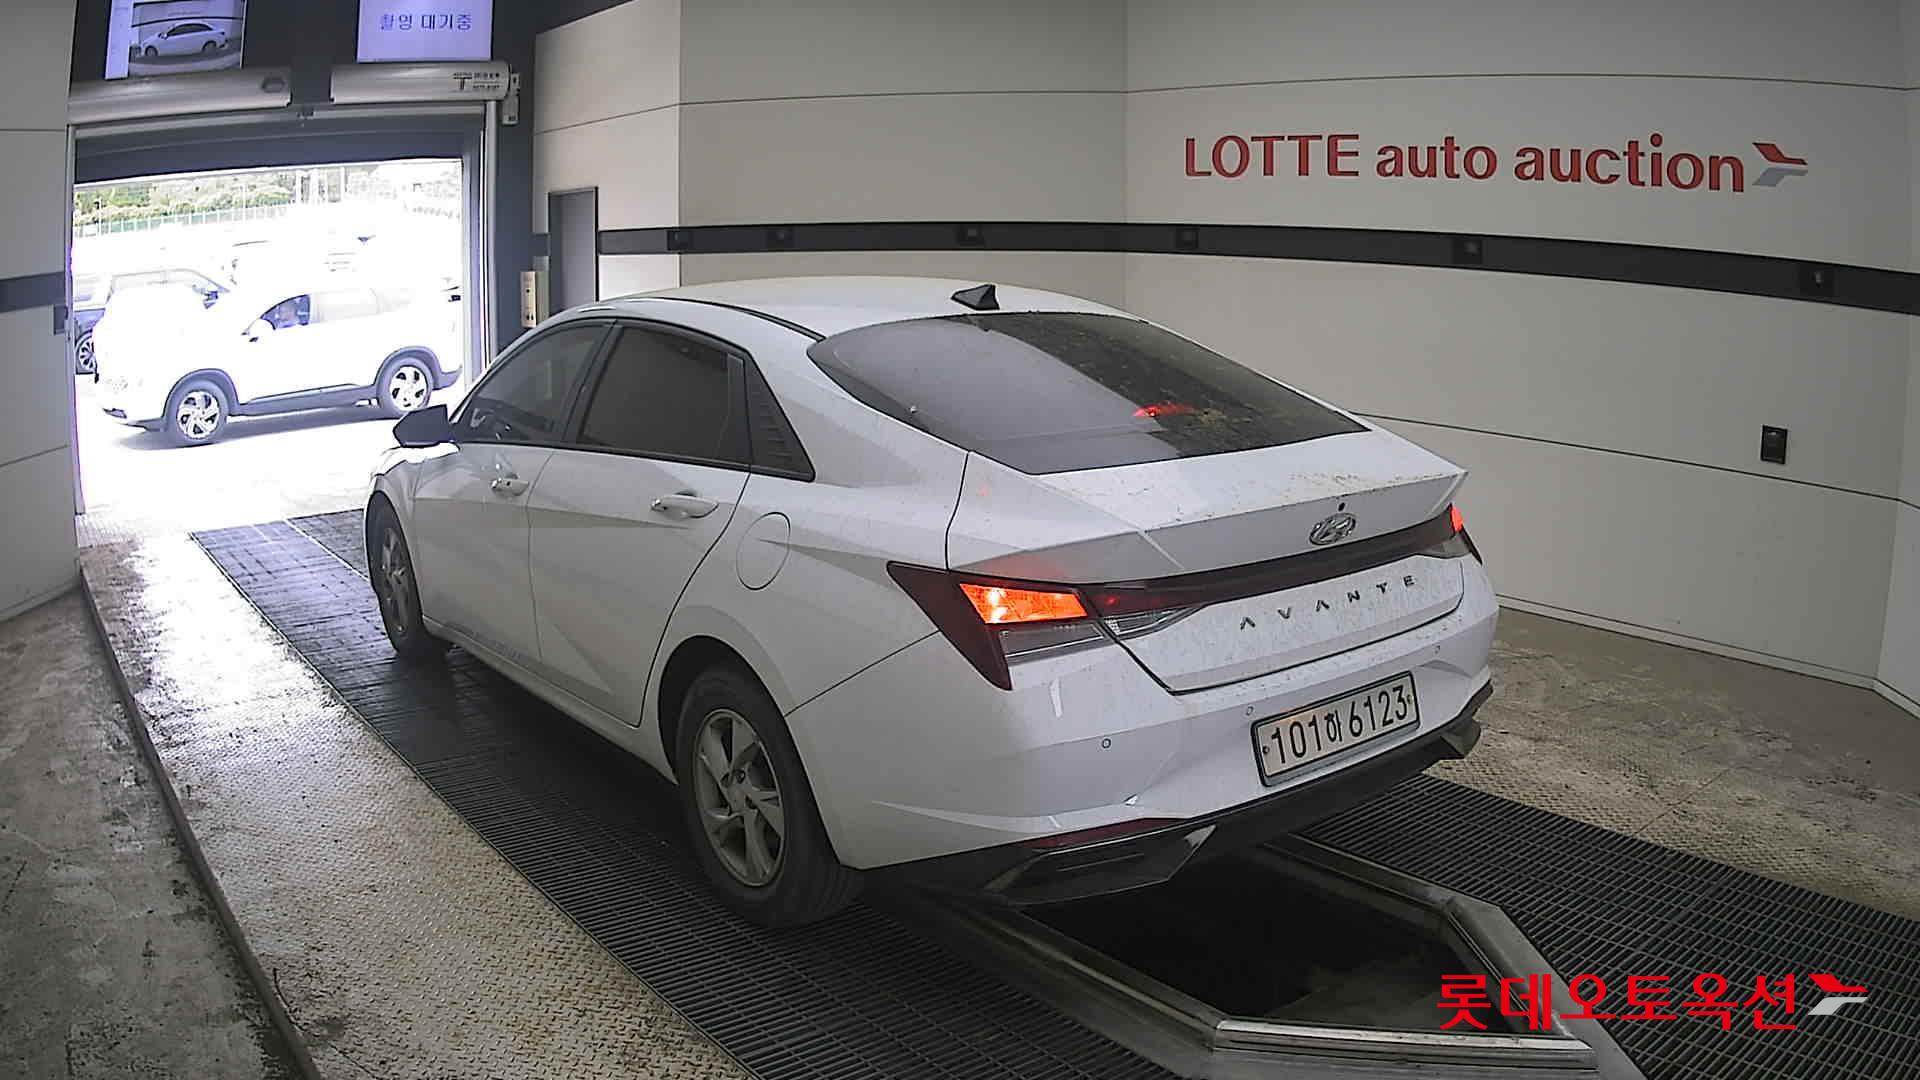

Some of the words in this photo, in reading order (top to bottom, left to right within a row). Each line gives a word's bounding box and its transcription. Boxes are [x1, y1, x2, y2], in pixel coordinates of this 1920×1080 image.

[421, 13, 472, 31] 대기중
[1185, 133, 1360, 178] LOTTE
[1376, 136, 1498, 180] auto
[1514, 133, 1745, 193] auction
[1240, 575, 1416, 630] AVANTE
